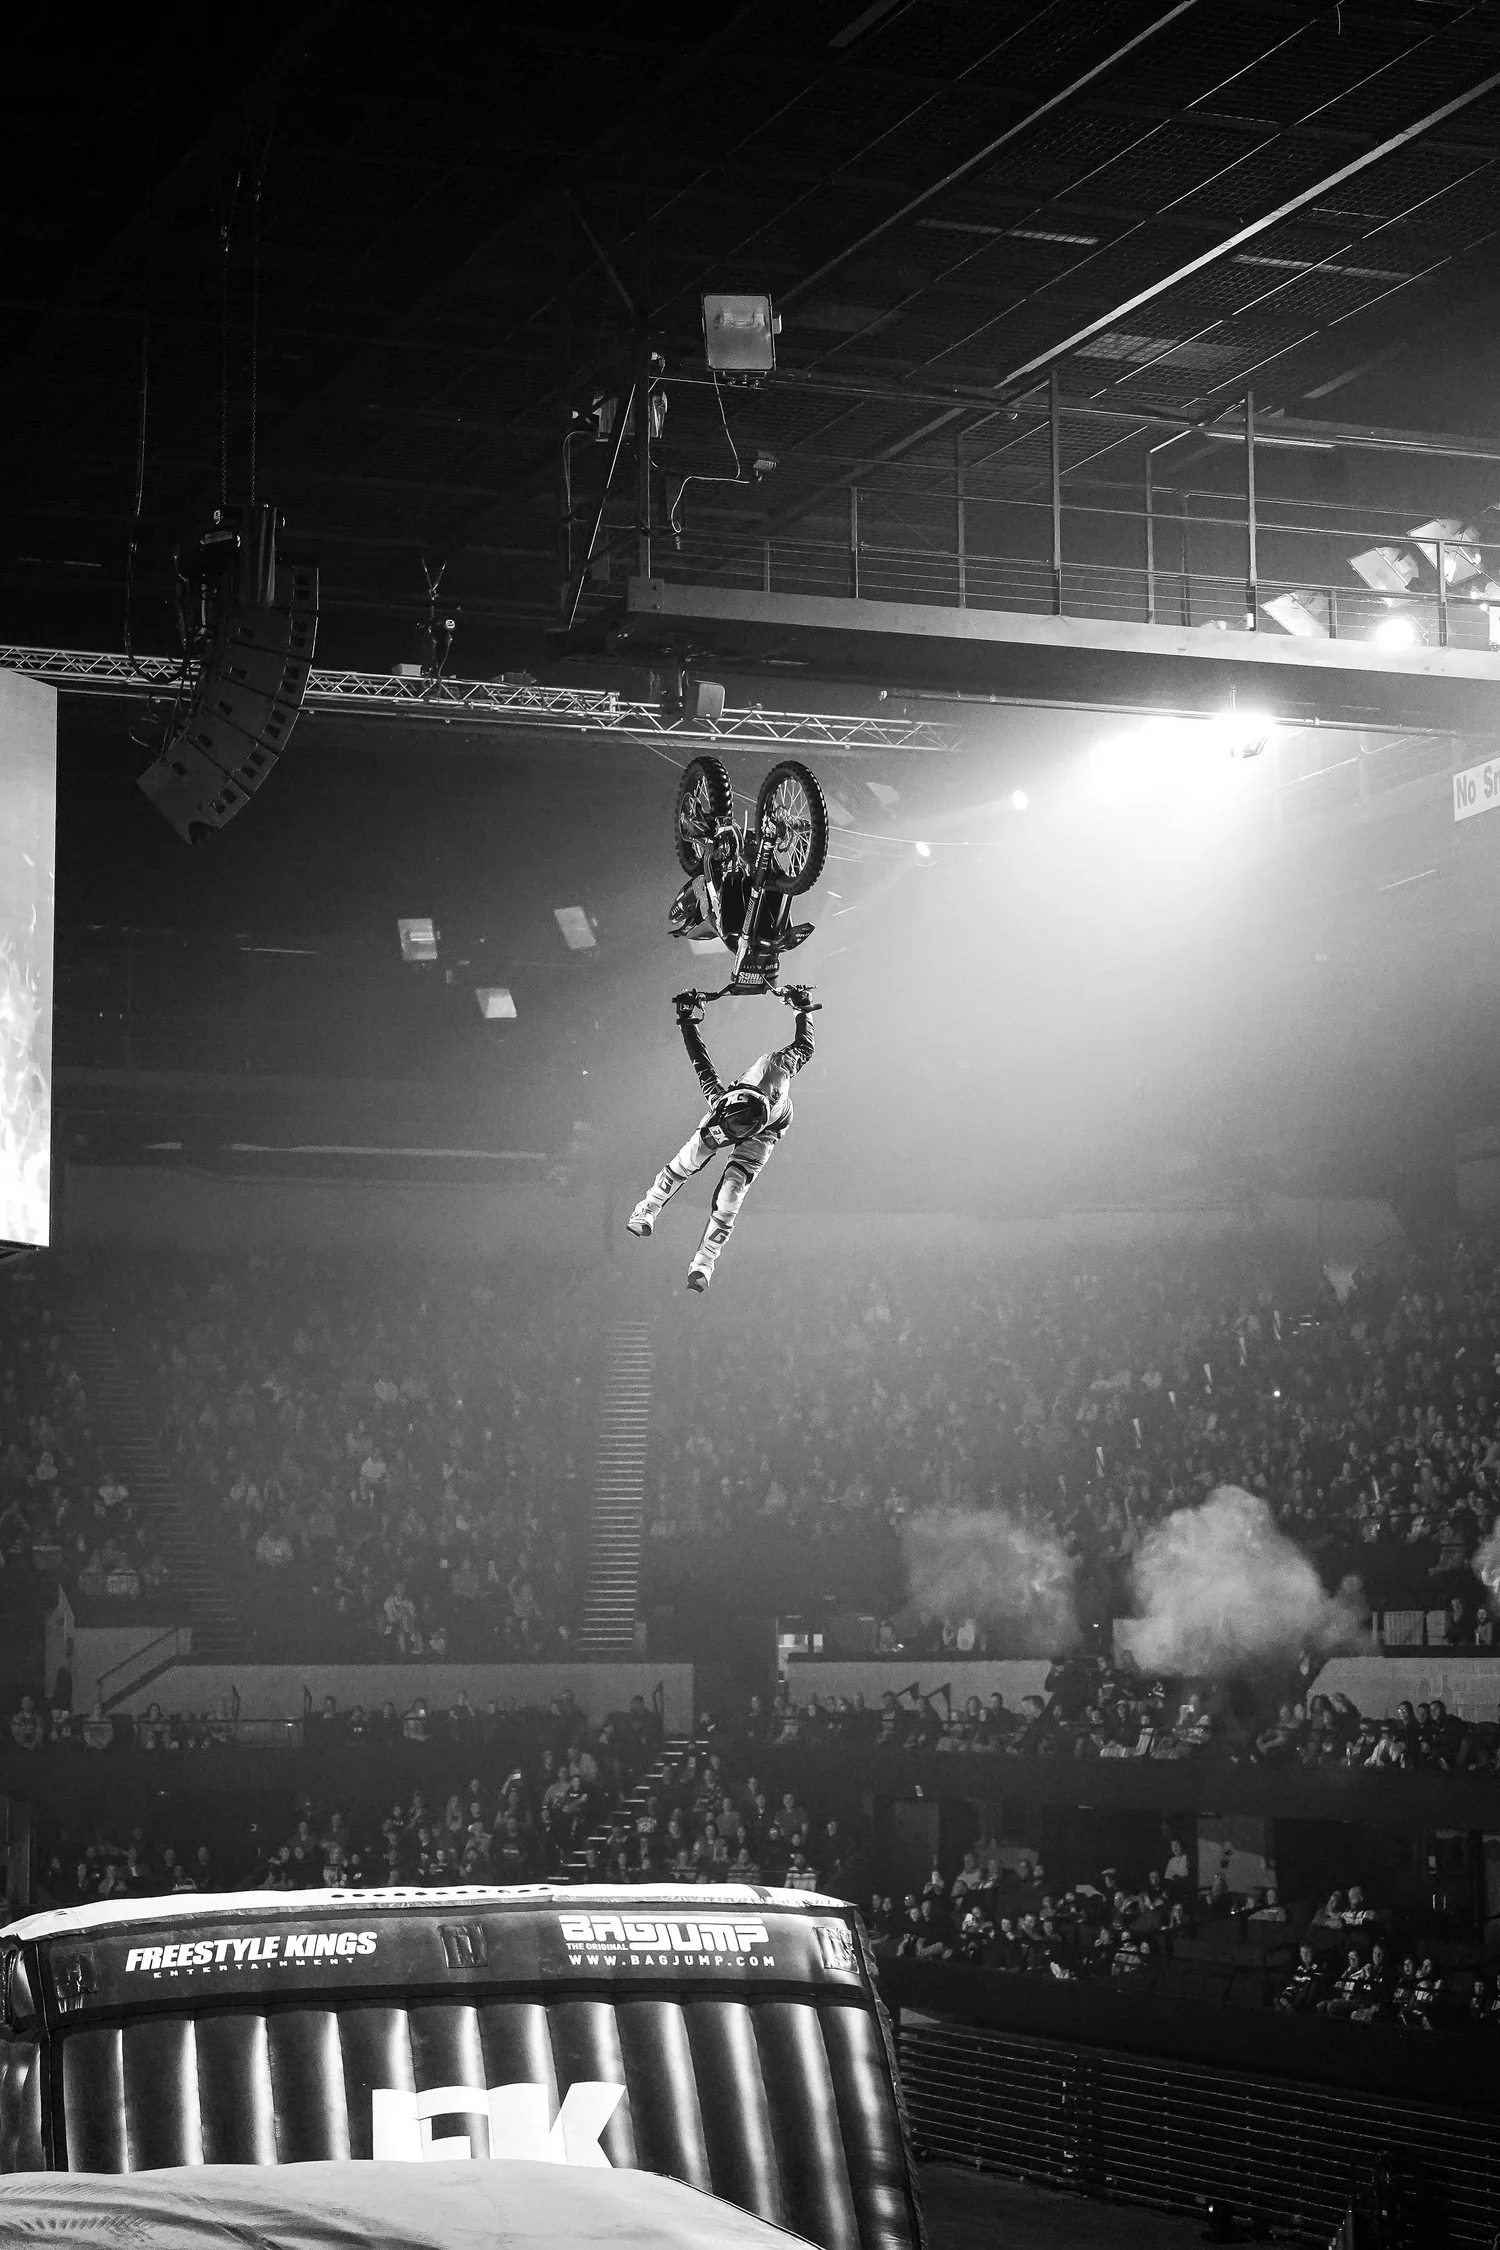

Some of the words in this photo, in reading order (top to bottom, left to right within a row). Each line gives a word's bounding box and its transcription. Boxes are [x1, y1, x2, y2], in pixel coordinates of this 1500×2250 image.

[1456, 774, 1476, 809] No
[558, 1914, 769, 1952] BAGJUMP
[566, 1942, 584, 1950] THE
[585, 1942, 629, 1951] ORIGINAL
[125, 1935, 281, 1972] FREESTYLE
[284, 1931, 378, 1958] KINGS
[568, 1954, 775, 1967] WWW.BAGJUMP.COM
[153, 1957, 355, 1979] ENTERTAINMENT
